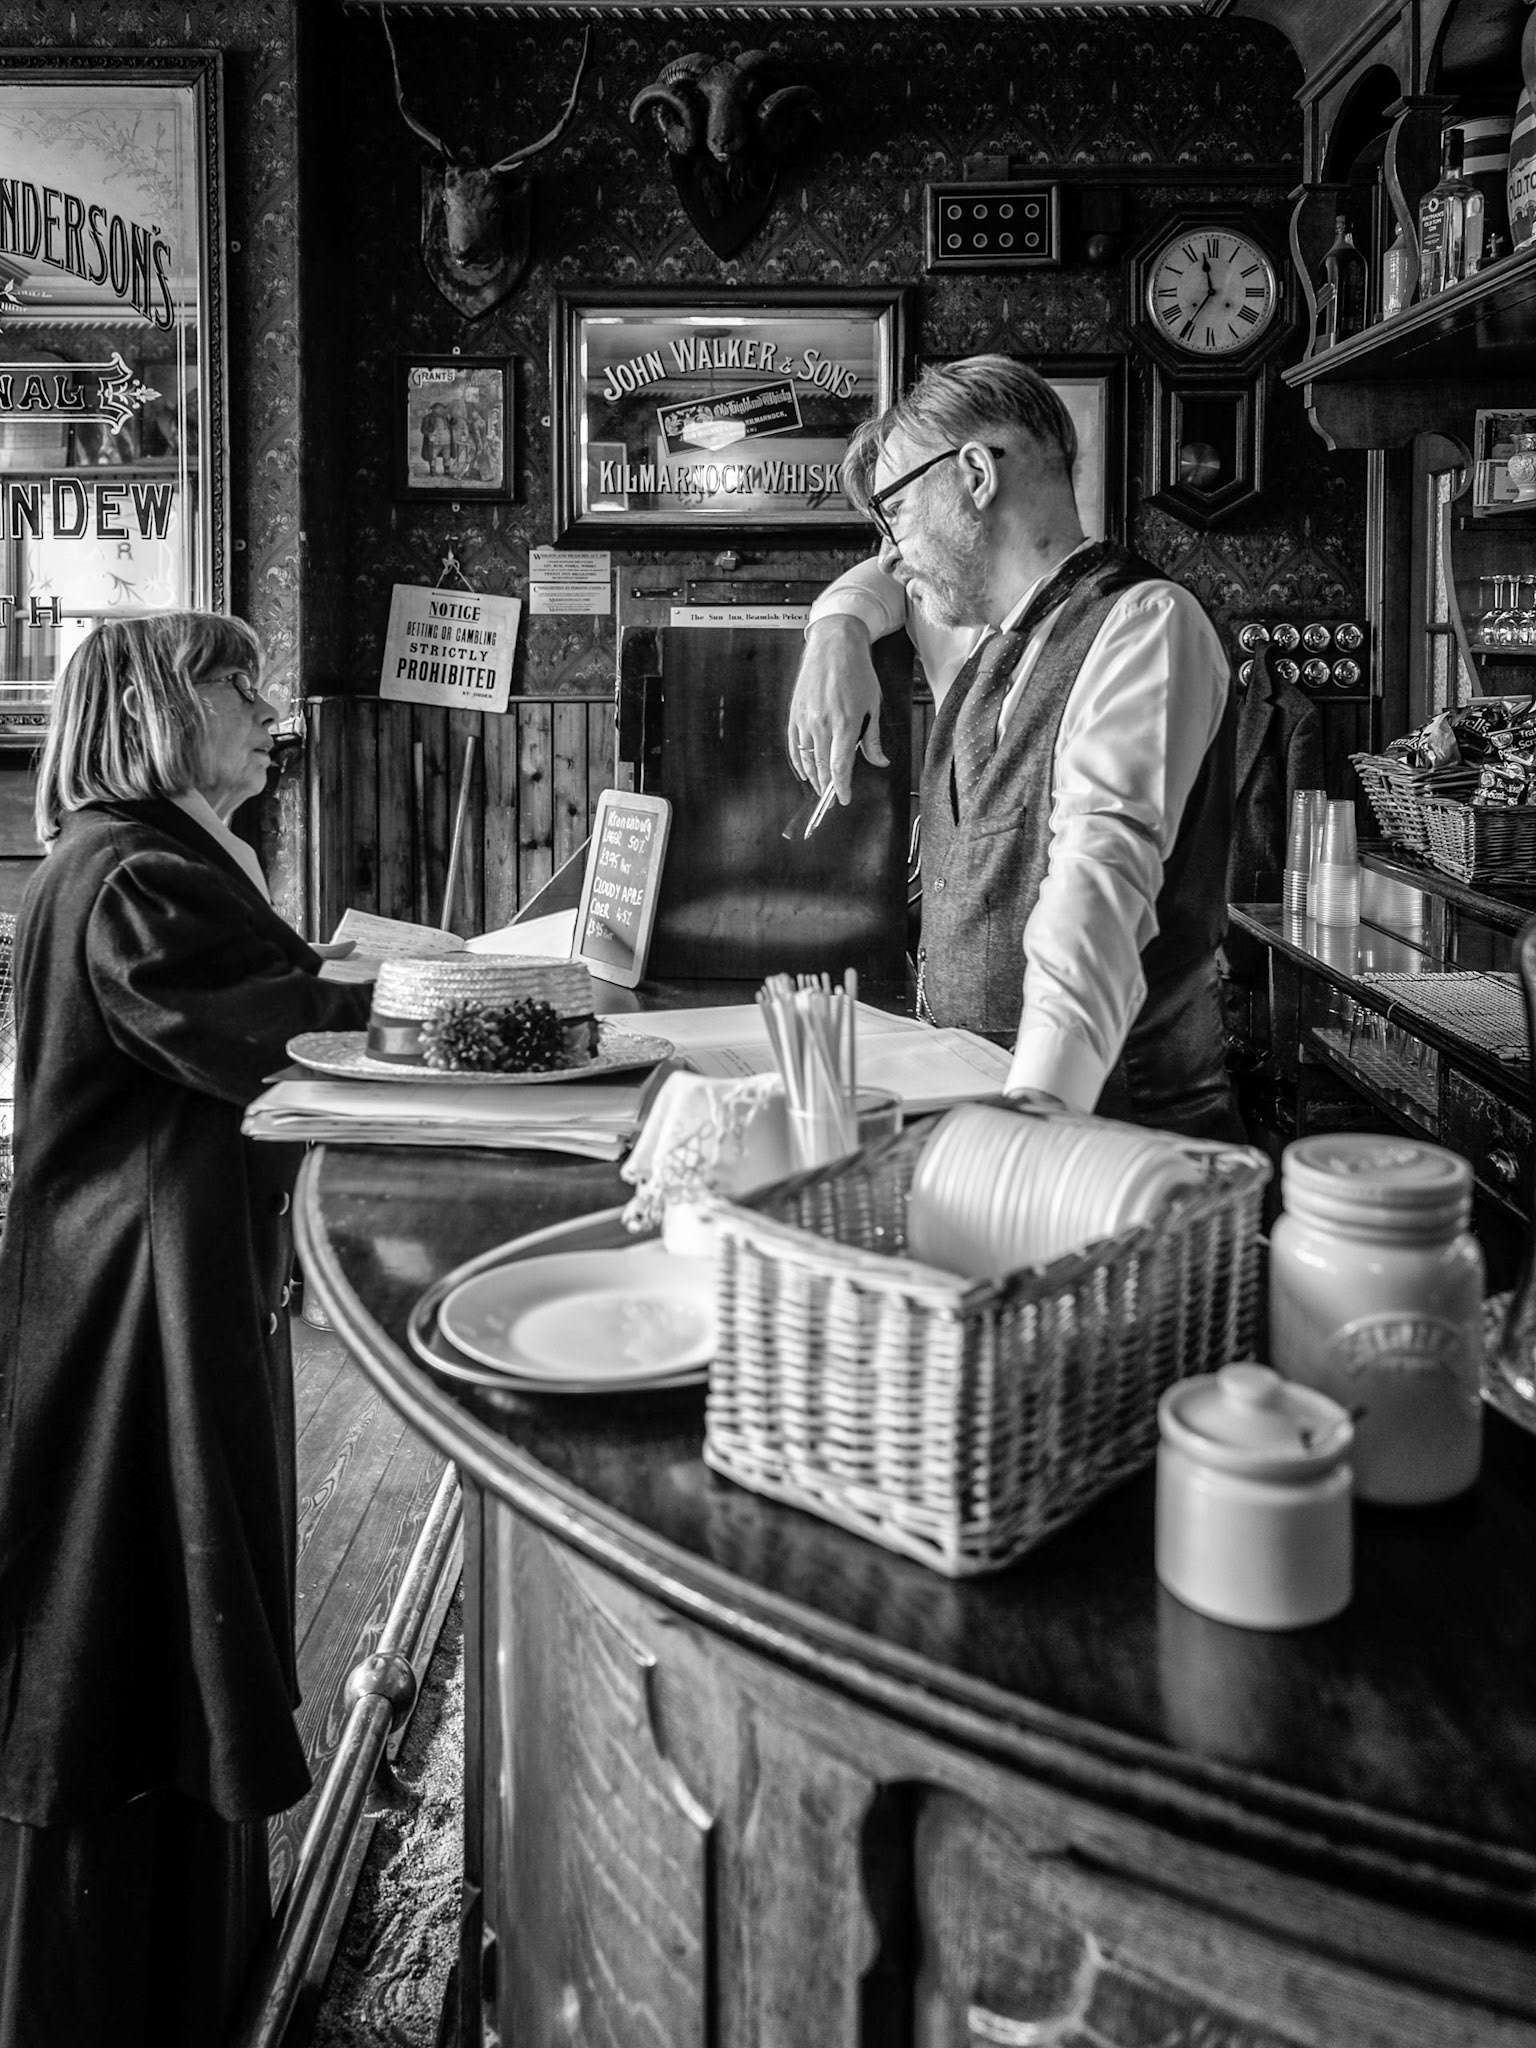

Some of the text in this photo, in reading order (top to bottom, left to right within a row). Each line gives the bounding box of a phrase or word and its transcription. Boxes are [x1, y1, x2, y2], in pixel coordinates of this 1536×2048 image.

[603, 337, 859, 401] JOHN WALKER & SONS
[600, 460, 754, 494] KILMARNOCK
[429, 601, 481, 621] NOTICE
[746, 613, 779, 621] Beamish
[782, 613, 805, 621] Price
[406, 621, 497, 646] BETTING OR GAMBLING
[410, 643, 488, 662] STRICTLY
[396, 658, 496, 690] PROHIBITED
[594, 876, 621, 900] CLOUDY
